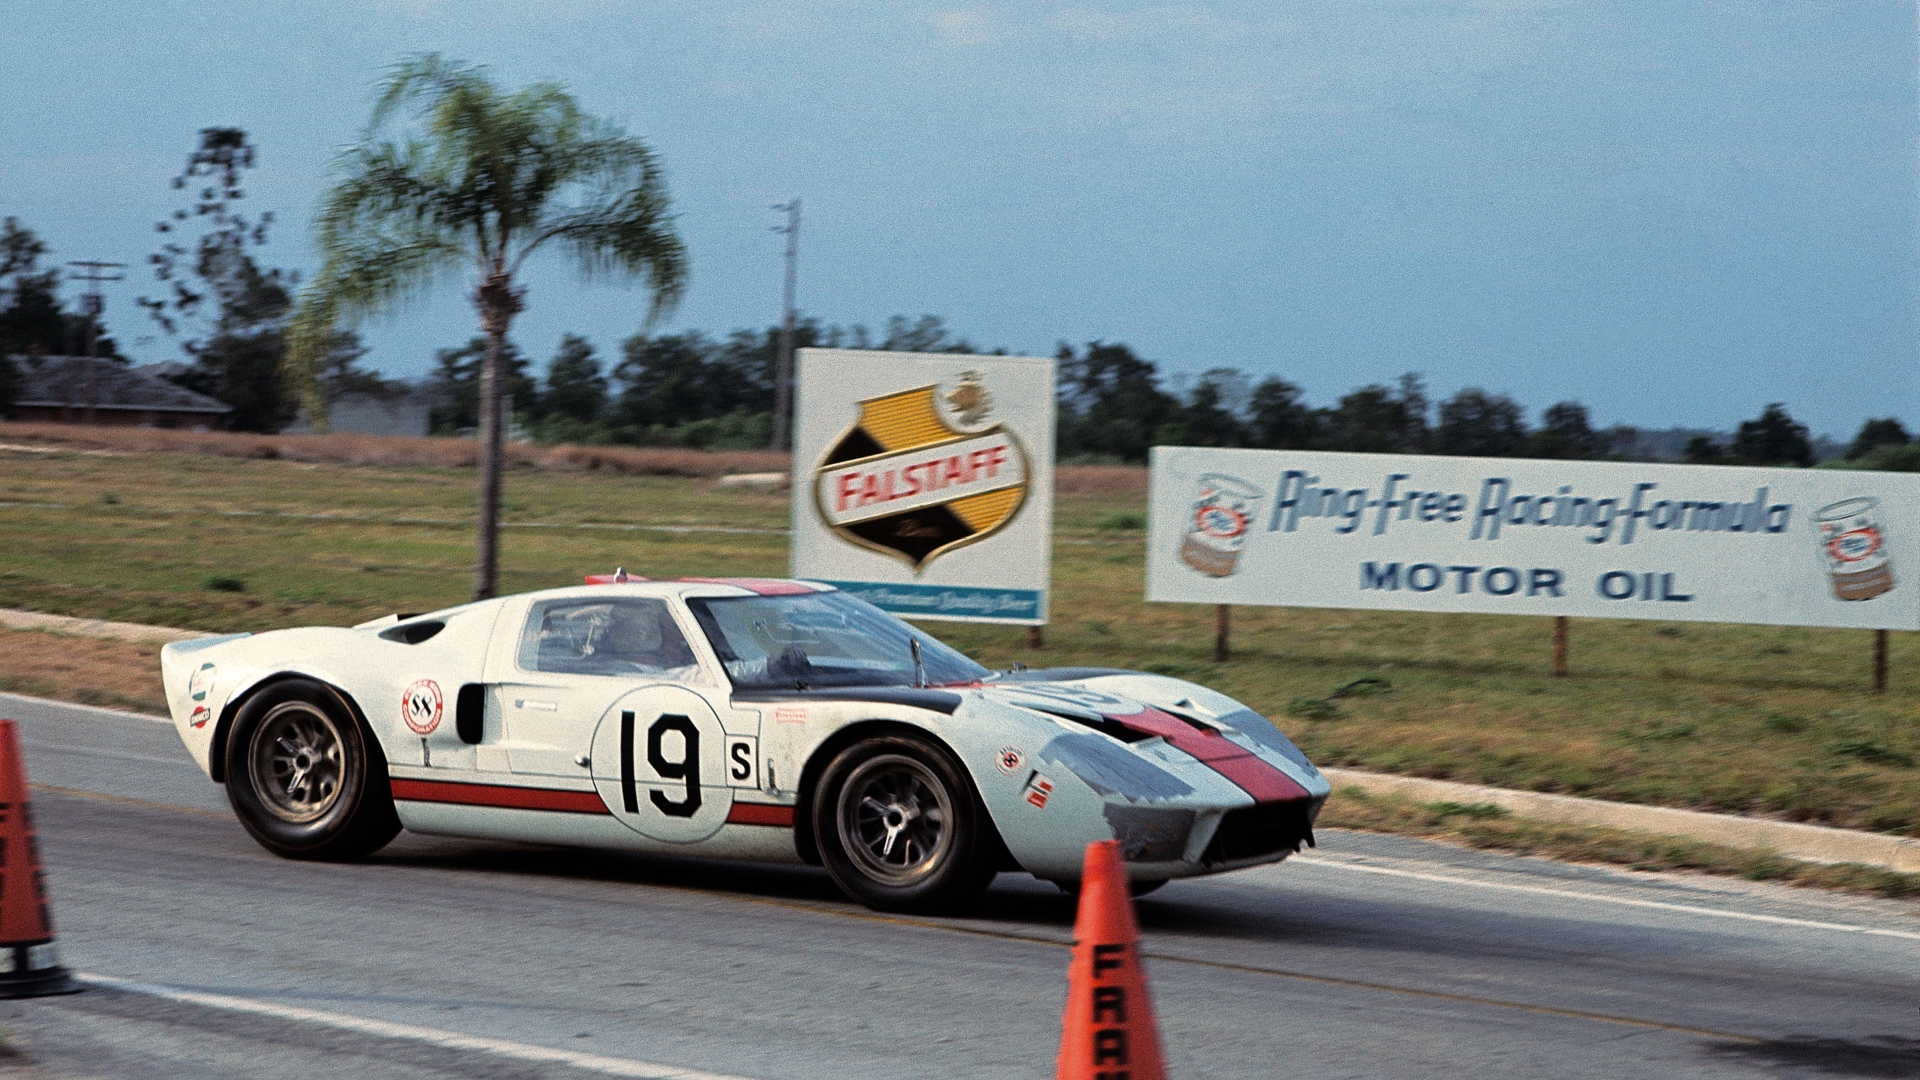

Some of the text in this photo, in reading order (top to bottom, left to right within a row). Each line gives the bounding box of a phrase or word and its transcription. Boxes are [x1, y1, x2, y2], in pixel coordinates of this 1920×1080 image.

[835, 445, 1008, 512] FALSTAFF
[1359, 561, 1694, 601] MOTOR OIL
[620, 710, 702, 818] 19
[731, 742, 751, 780] S
[1092, 943, 1129, 1080] FRA
